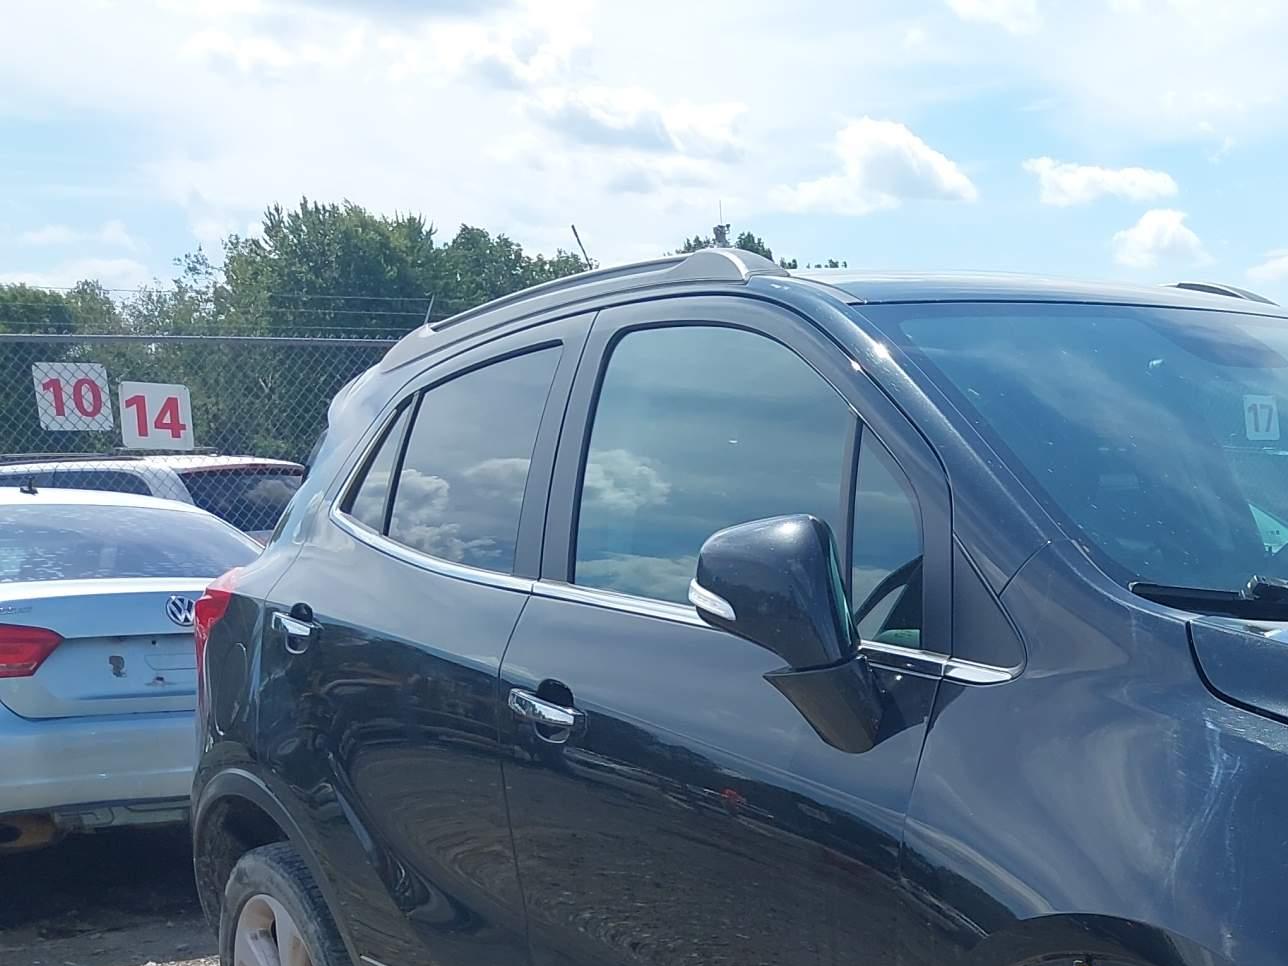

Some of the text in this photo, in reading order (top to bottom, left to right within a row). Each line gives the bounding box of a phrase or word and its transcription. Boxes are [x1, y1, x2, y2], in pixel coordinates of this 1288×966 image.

[42, 378, 103, 418] 10
[125, 395, 186, 439] 14
[1247, 403, 1274, 433] 17
